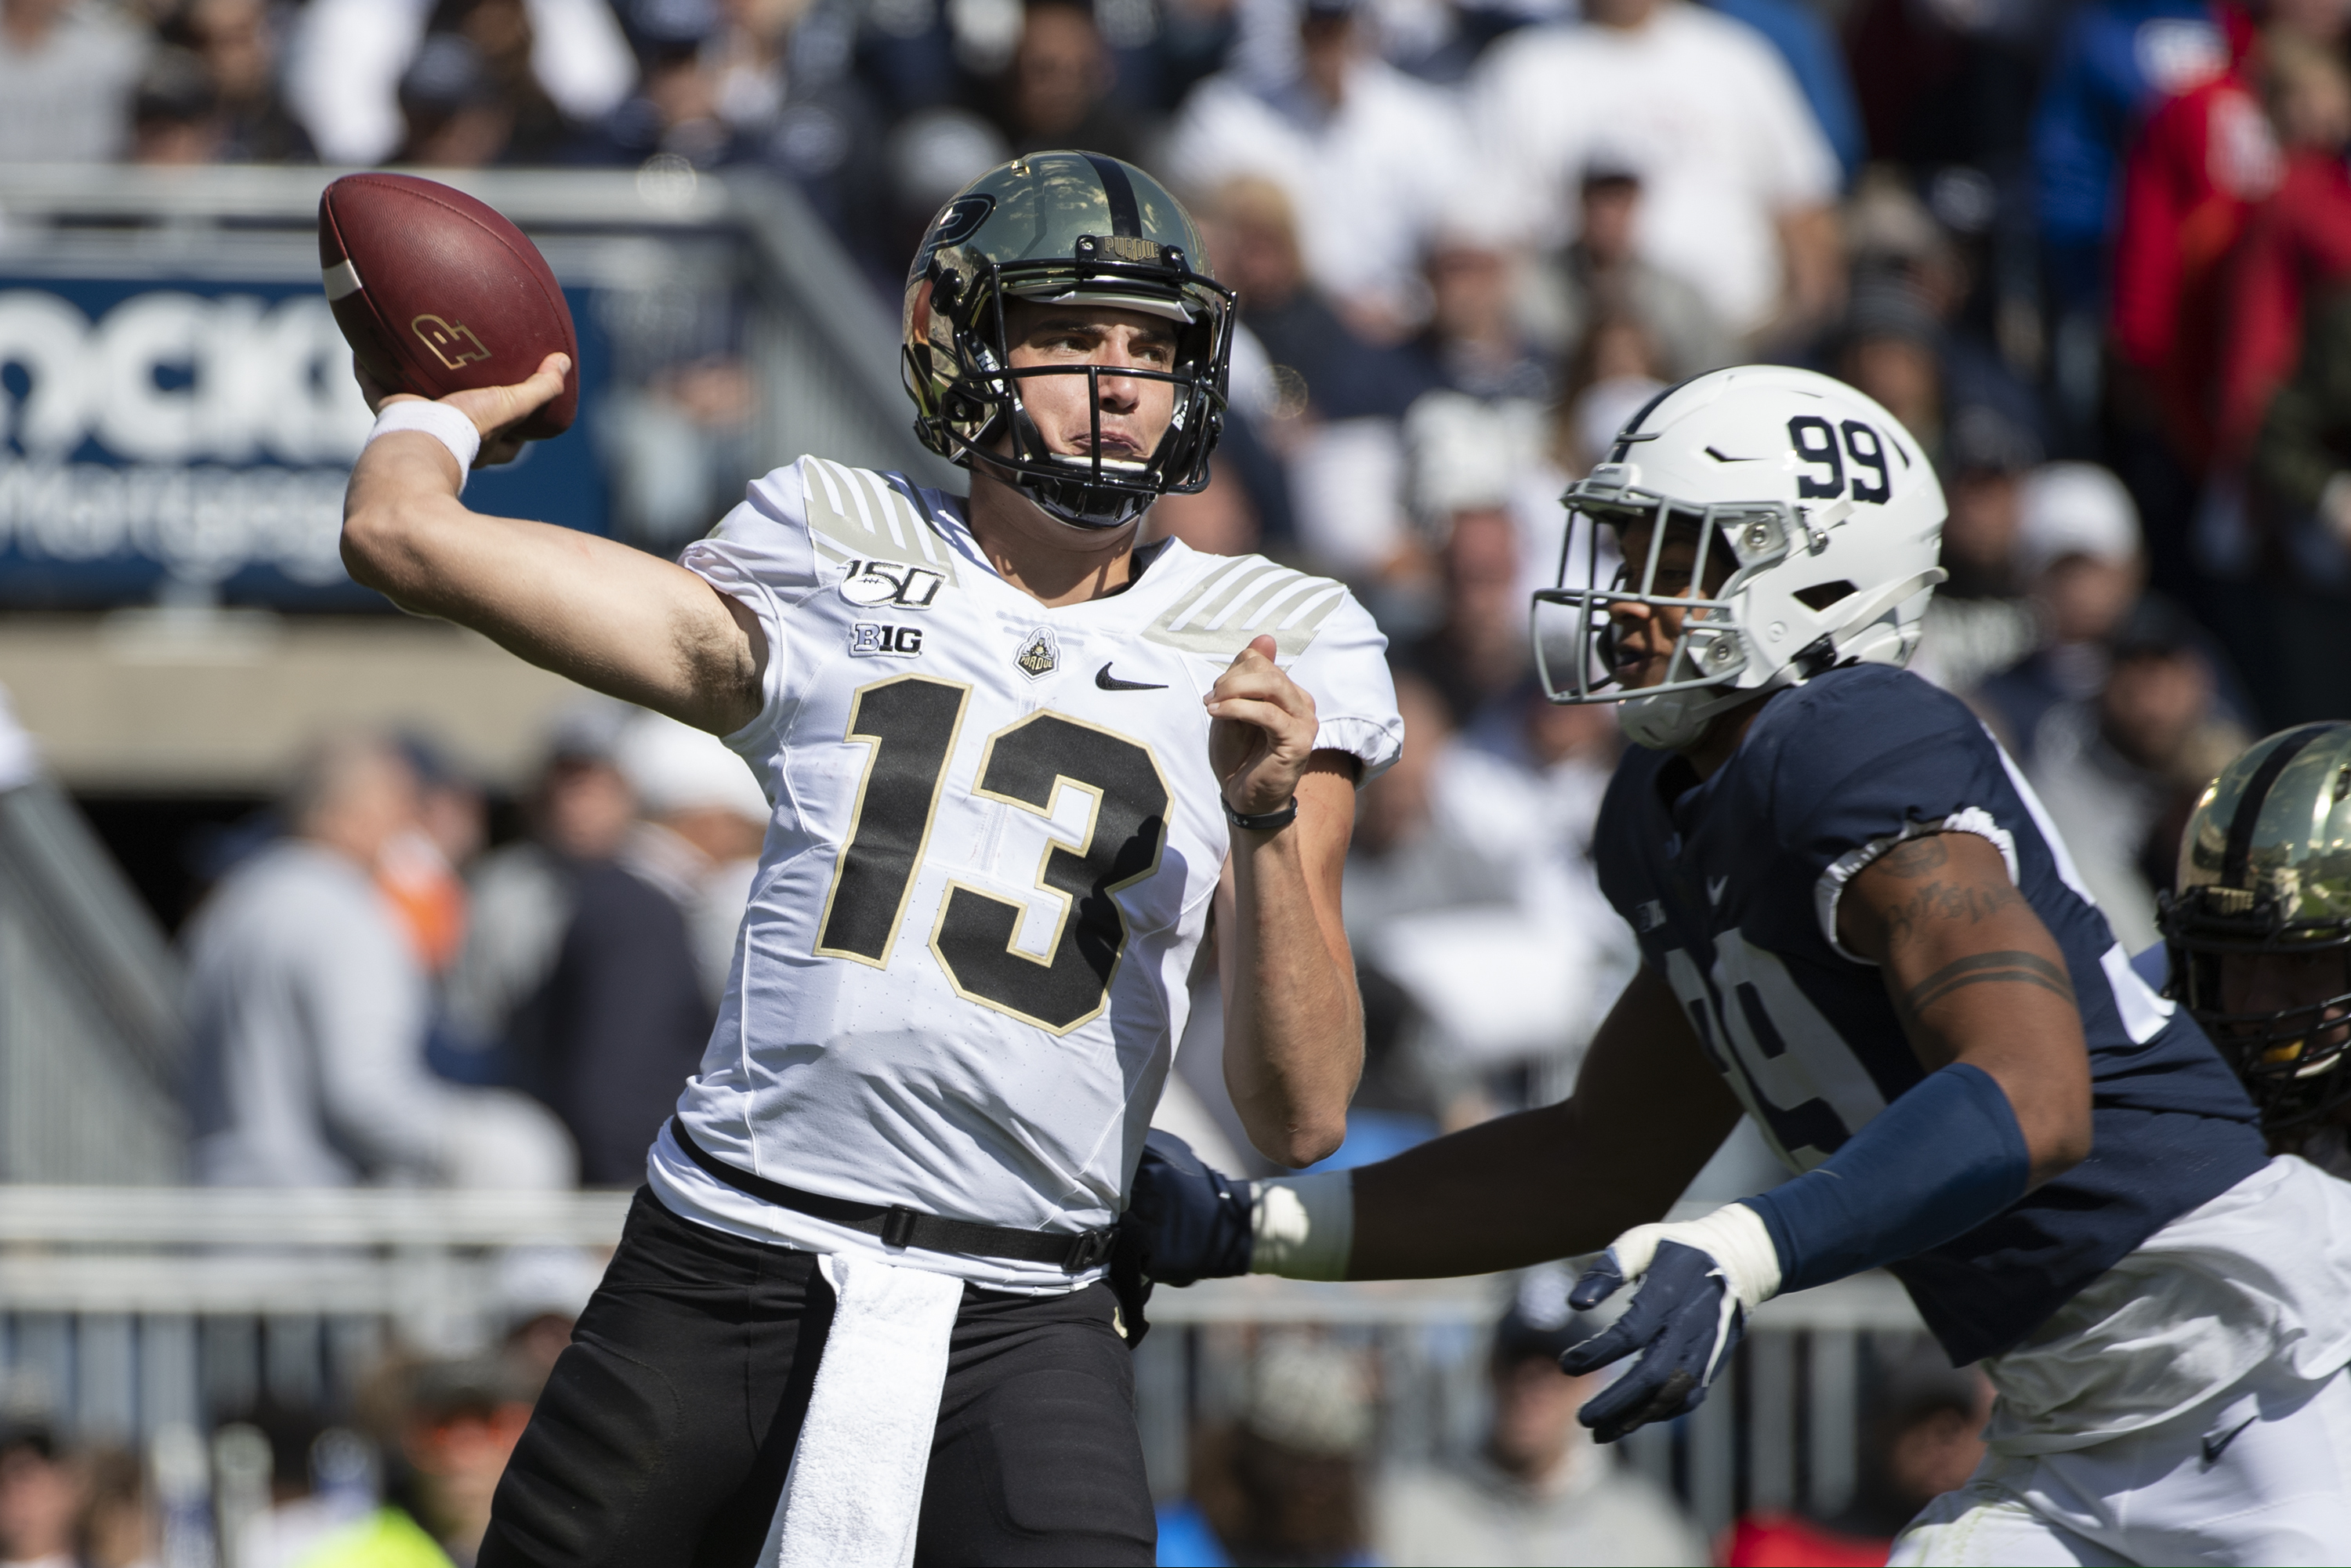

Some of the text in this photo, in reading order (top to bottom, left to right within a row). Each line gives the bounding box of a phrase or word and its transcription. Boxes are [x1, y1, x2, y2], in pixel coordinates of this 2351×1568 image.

[1103, 237, 1160, 263] PURDUE
[1786, 415, 1892, 505] 99
[837, 559, 946, 606] 150
[1020, 655, 1053, 672] PURDUE
[813, 673, 1173, 1036] 13
